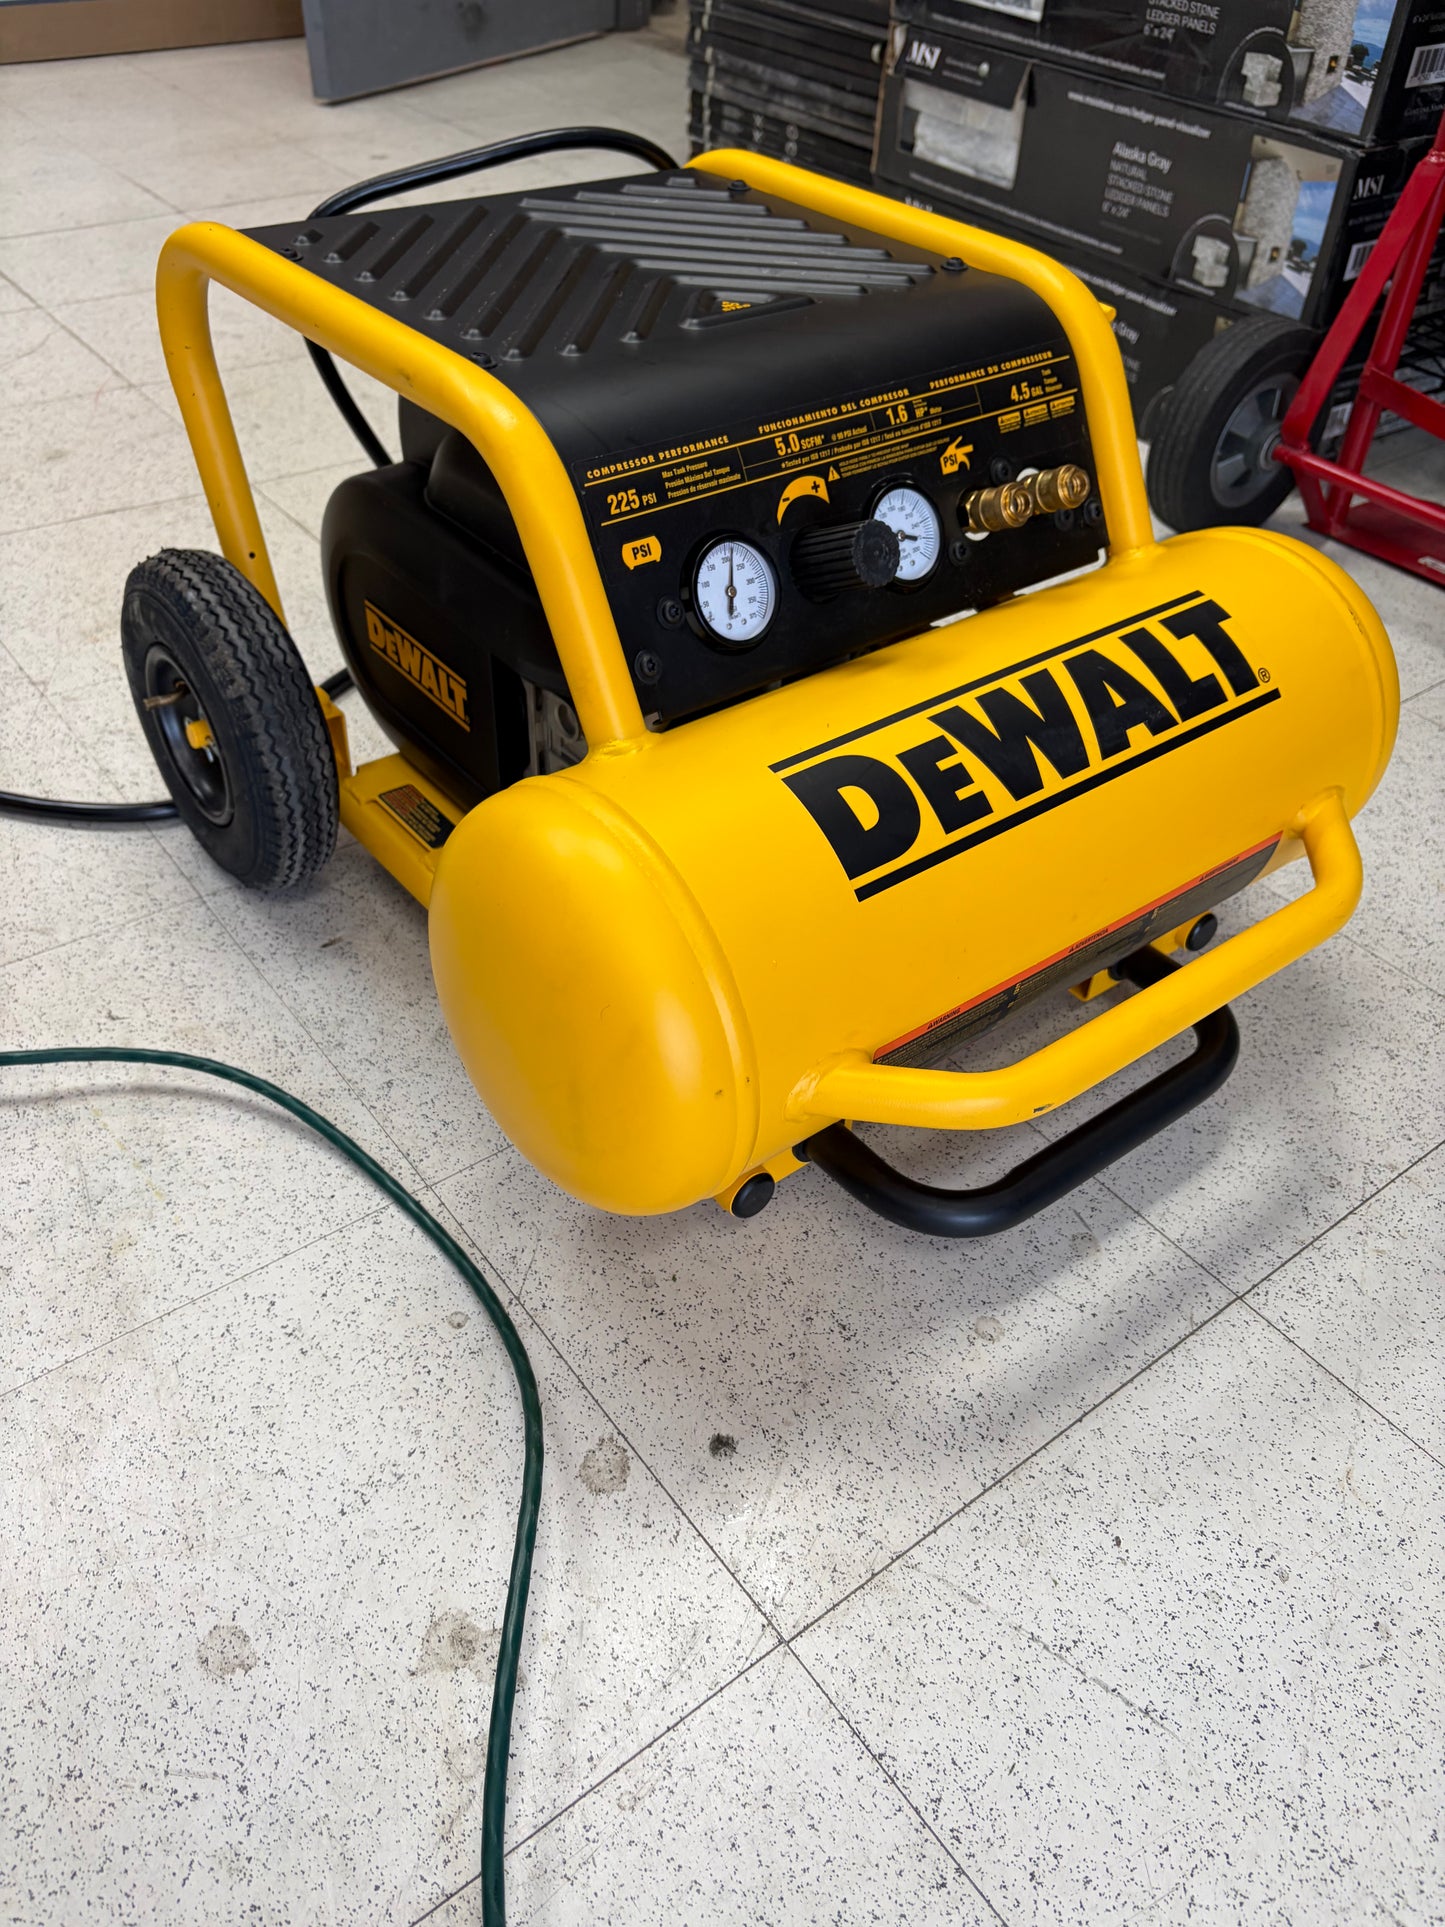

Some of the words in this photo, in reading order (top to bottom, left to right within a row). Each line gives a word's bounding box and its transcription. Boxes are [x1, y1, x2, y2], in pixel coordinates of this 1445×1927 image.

[1146, 8, 1180, 26] LEDGER
[1182, 16, 1216, 35] PANELS
[1190, 2, 1221, 19] STONE
[906, 40, 941, 70] MSI
[1112, 141, 1147, 164] Alaska
[1148, 151, 1172, 174] Gray
[1353, 175, 1384, 200] MSI
[929, 367, 985, 389] PERFORMANCE
[987, 365, 998, 375] DU
[1000, 351, 1053, 371] COMPRESSEUR
[1010, 382, 1030, 402] 4.5
[1031, 386, 1044, 398] GAL
[758, 408, 838, 434] FUNCIONAMIENTO
[841, 403, 857, 413] DEL
[860, 388, 909, 407] COMPRESOR
[886, 404, 908, 426] 1.6
[774, 433, 800, 456] 5.0
[820, 450, 830, 459] 1217
[870, 435, 881, 444] 1217
[587, 455, 655, 479] COMPRESSOR
[658, 435, 729, 460] PERFORMANCE
[943, 454, 958, 468] PSI
[662, 470, 674, 479] Max
[673, 466, 687, 476] Tank
[686, 461, 708, 473] Pressure
[665, 478, 684, 489] Presión
[713, 466, 730, 478] Tanque
[607, 488, 640, 515] 225
[642, 492, 657, 506] PSI
[668, 487, 689, 499] Pression
[690, 485, 696, 493] de
[632, 543, 652, 560] PSI
[721, 556, 730, 564] 200
[707, 563, 716, 571] 150
[736, 563, 745, 571] 250
[748, 596, 756, 604] 350
[933, 1008, 960, 1026] WARNING
